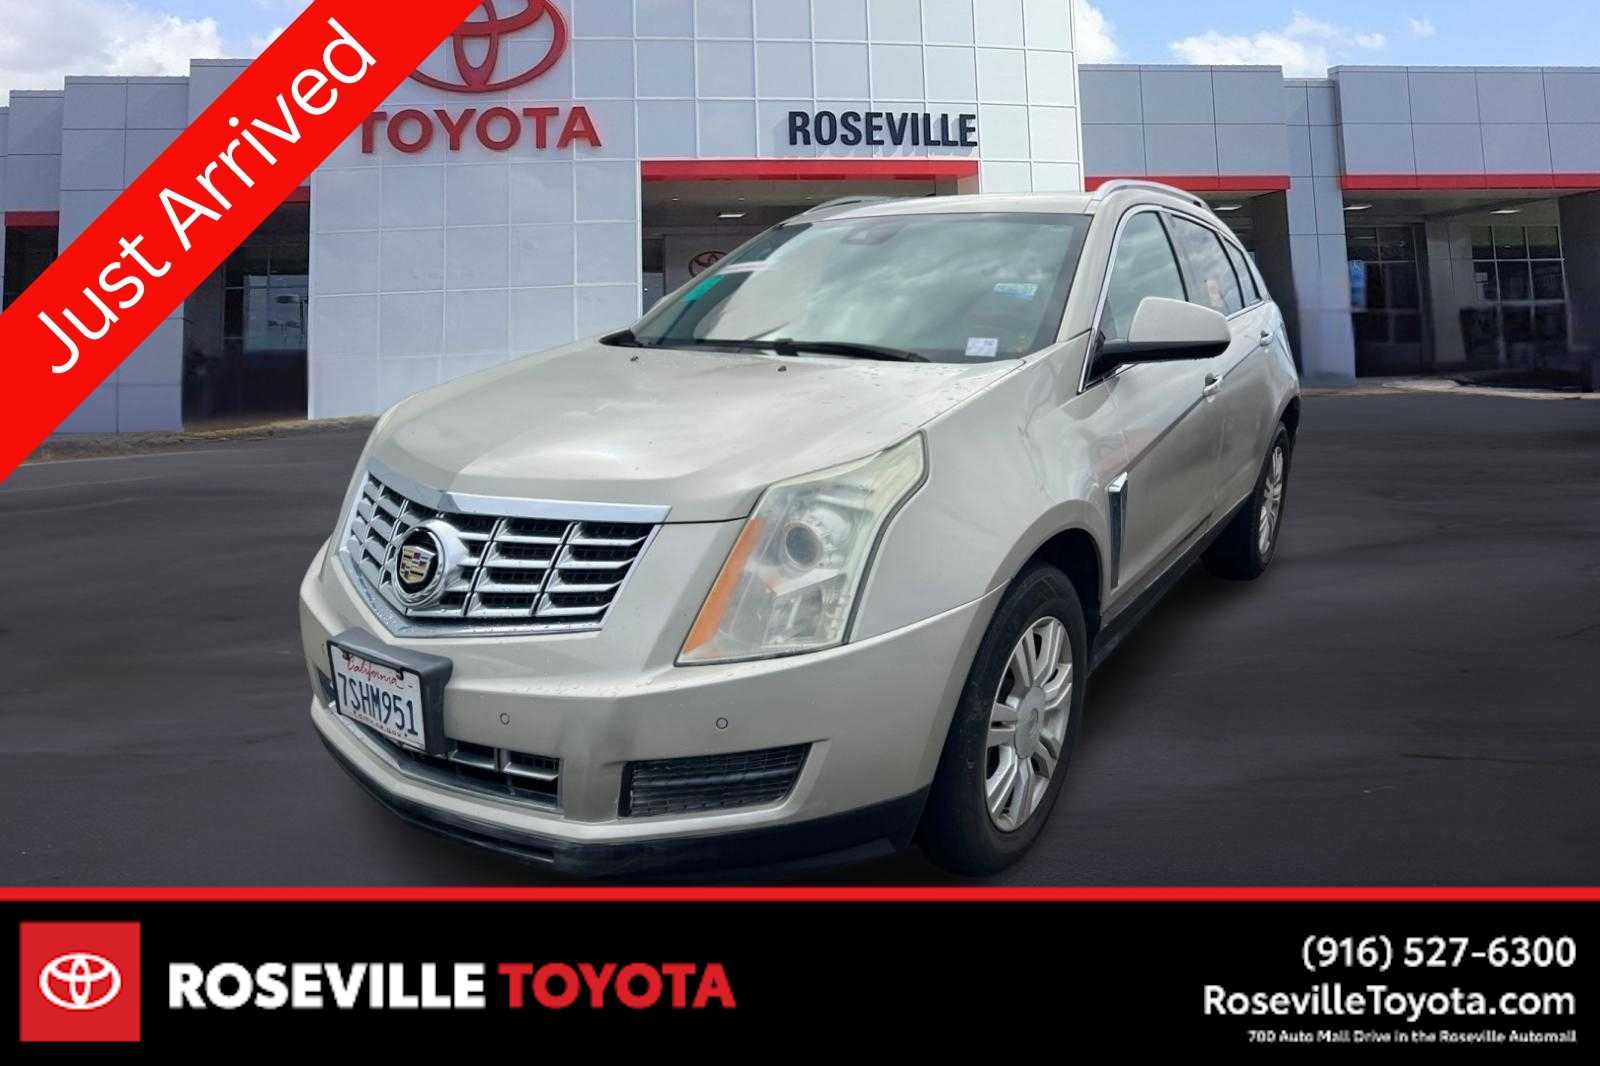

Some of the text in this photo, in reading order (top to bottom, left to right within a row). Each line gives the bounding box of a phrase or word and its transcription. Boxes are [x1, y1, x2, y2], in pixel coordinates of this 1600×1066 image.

[361, 106, 602, 154] TOYOTA
[787, 110, 979, 147] ROSEVILLE
[338, 672, 418, 736] 7SHM951
